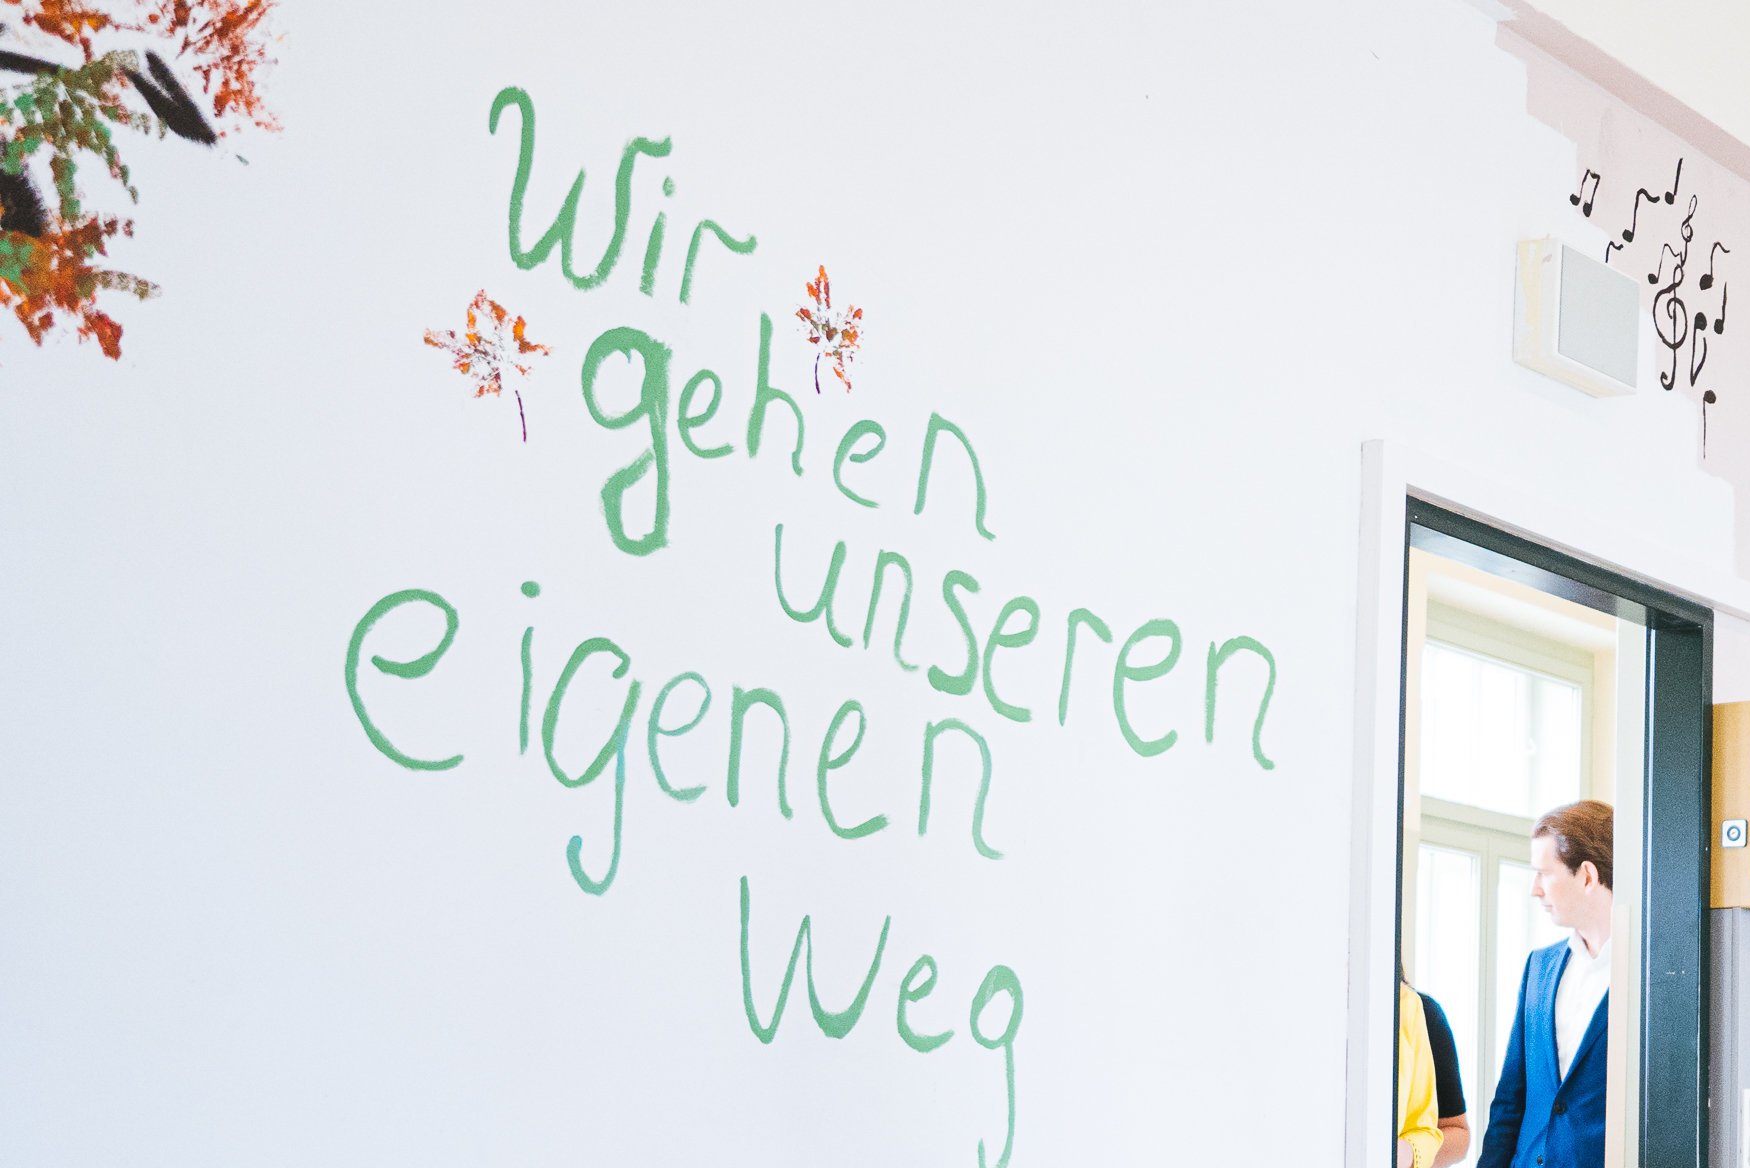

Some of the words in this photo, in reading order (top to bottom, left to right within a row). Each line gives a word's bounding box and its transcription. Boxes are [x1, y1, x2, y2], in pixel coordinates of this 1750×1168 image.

[488, 85, 758, 305] Wir
[580, 311, 997, 557] gehen
[344, 580, 1004, 896] eigenen
[774, 523, 1278, 772] unseren
